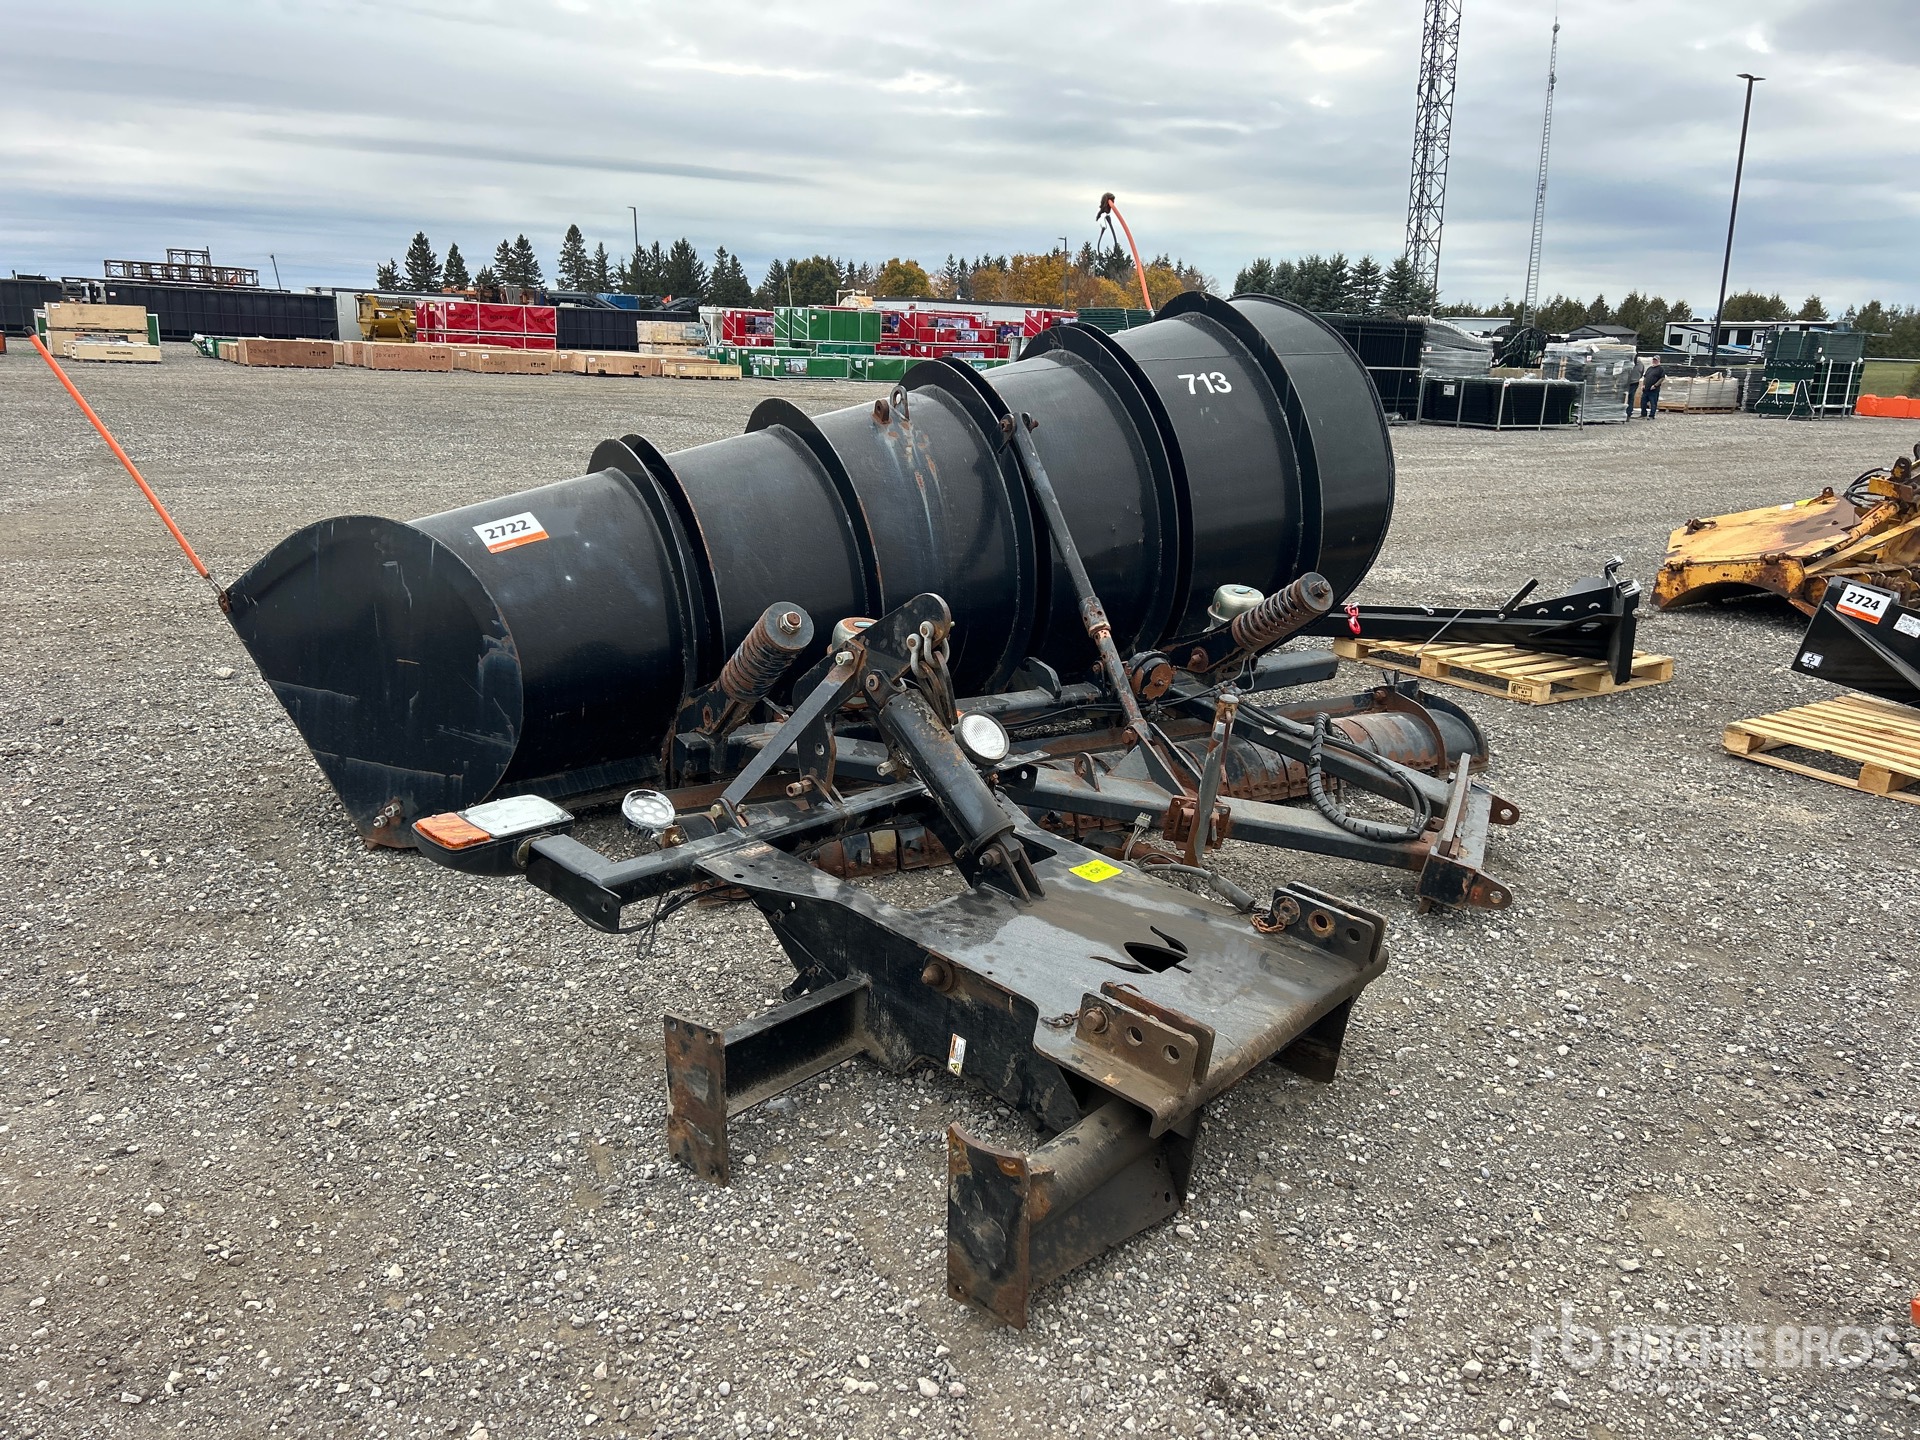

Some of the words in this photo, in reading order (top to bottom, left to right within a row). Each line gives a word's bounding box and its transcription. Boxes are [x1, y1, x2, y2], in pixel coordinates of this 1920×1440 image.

[1177, 371, 1232, 395] 713
[484, 520, 531, 539] 2722
[1846, 591, 1881, 611] 2724
